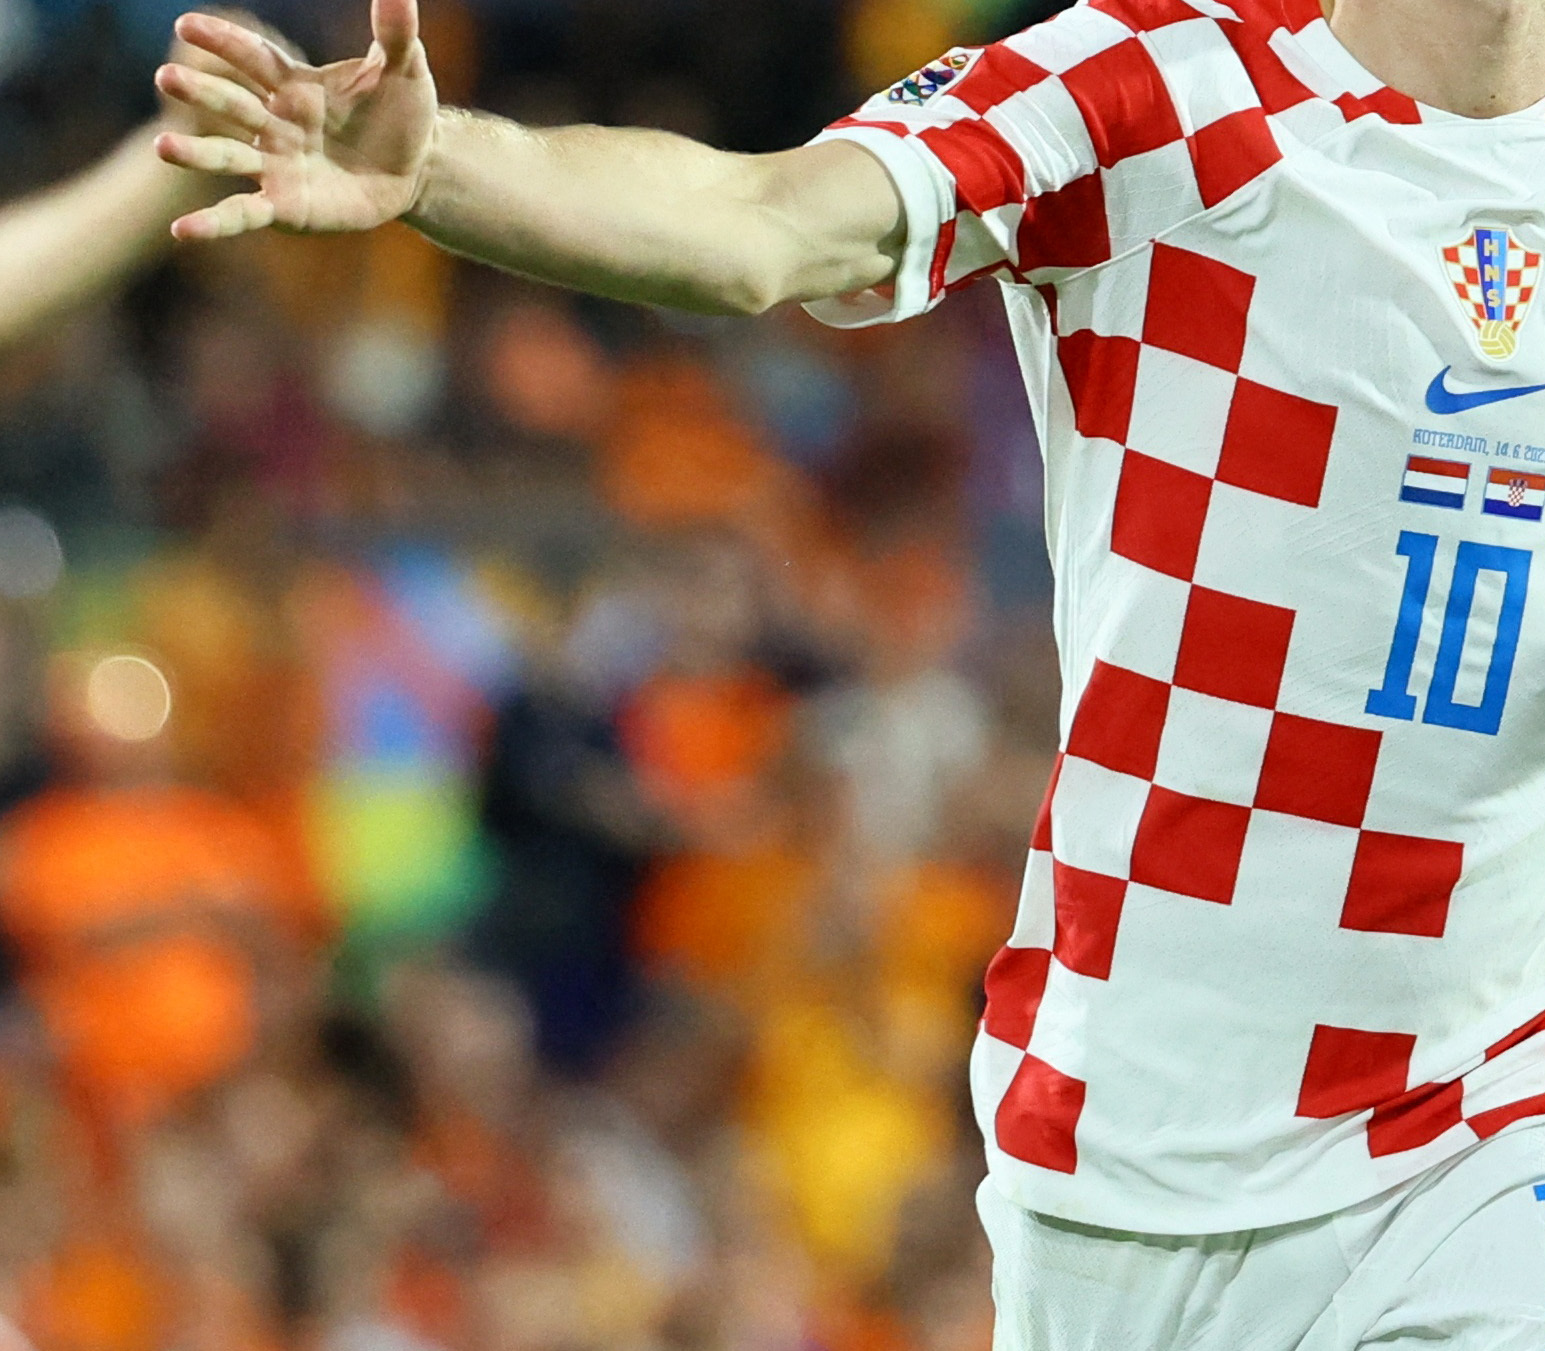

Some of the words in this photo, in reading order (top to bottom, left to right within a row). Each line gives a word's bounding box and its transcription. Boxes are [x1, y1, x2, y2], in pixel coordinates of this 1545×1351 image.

[1483, 238, 1502, 308] HNS
[1412, 428, 1490, 456] ROTERDAM,
[1364, 529, 1533, 736] 10
